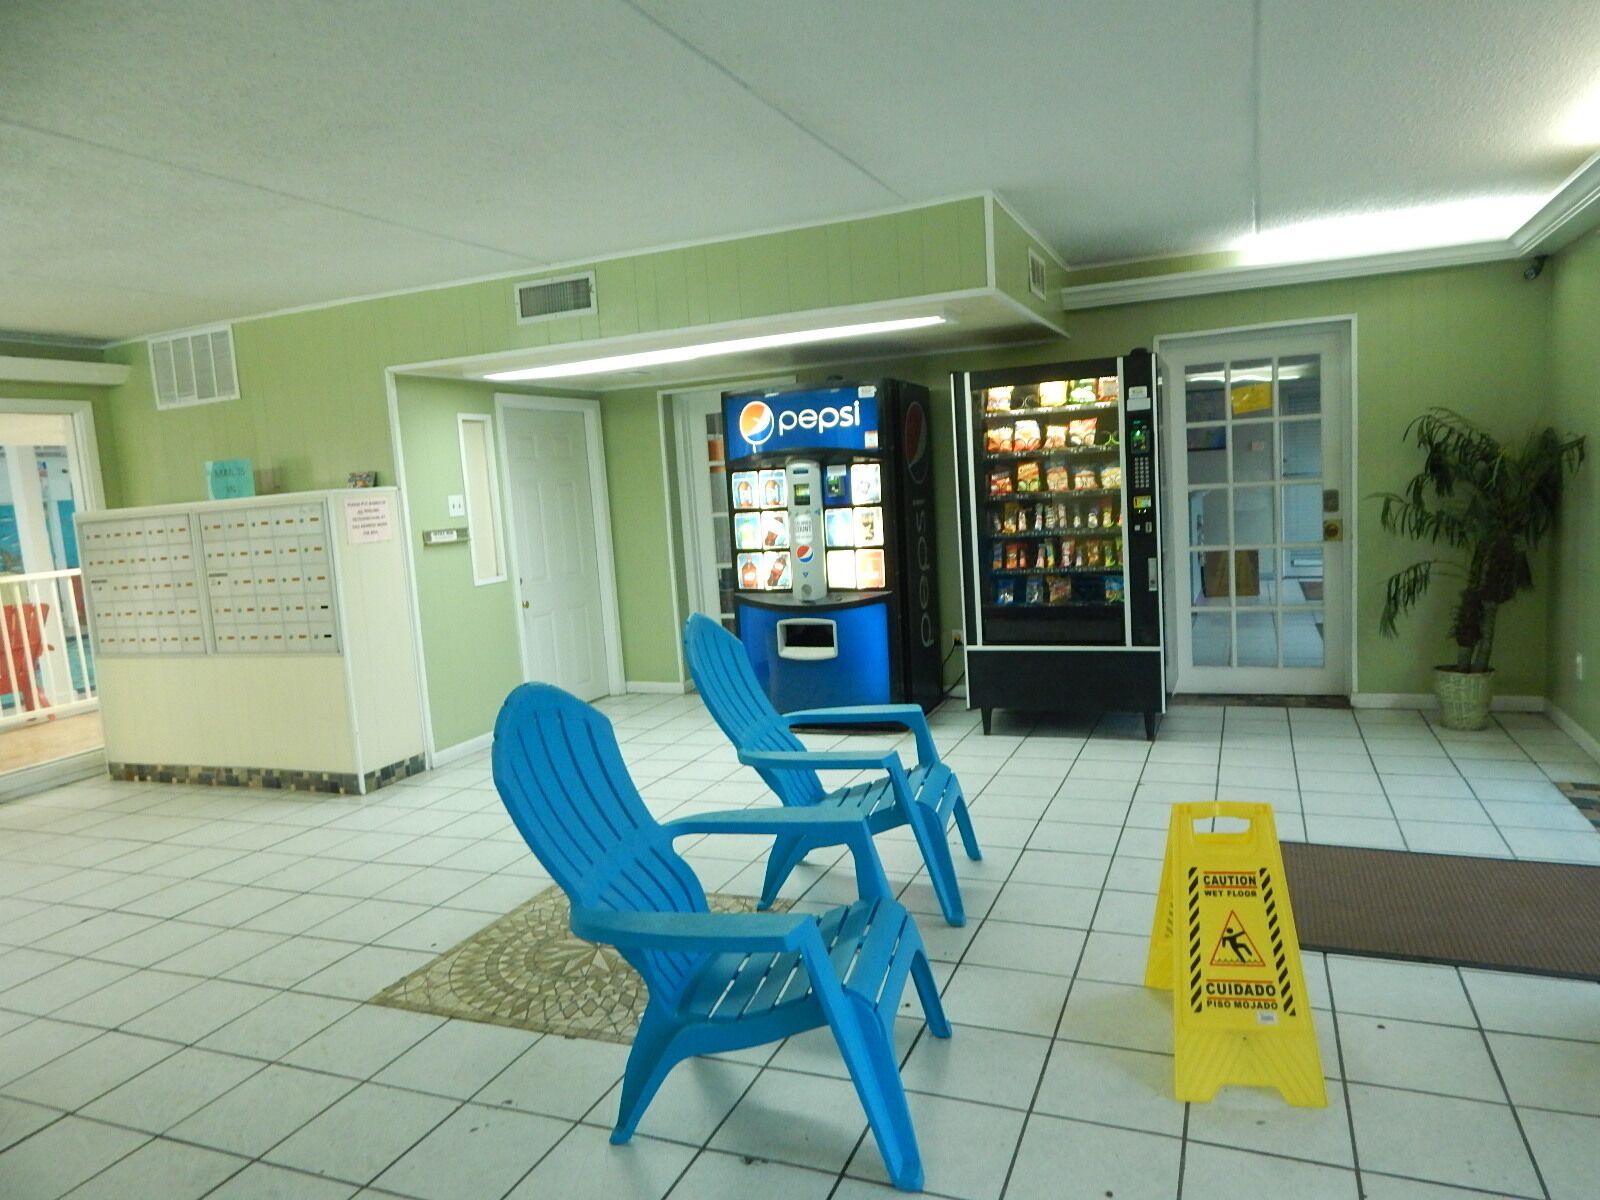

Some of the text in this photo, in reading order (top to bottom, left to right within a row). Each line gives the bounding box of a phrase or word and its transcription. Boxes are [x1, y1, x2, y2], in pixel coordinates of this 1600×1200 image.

[778, 400, 860, 436] pepsi
[912, 499, 934, 648] pepsi
[1203, 875, 1257, 885] CAUTION
[1206, 982, 1276, 996] CUIDADO
[1206, 1000, 1278, 1010] PISO MOJADO
